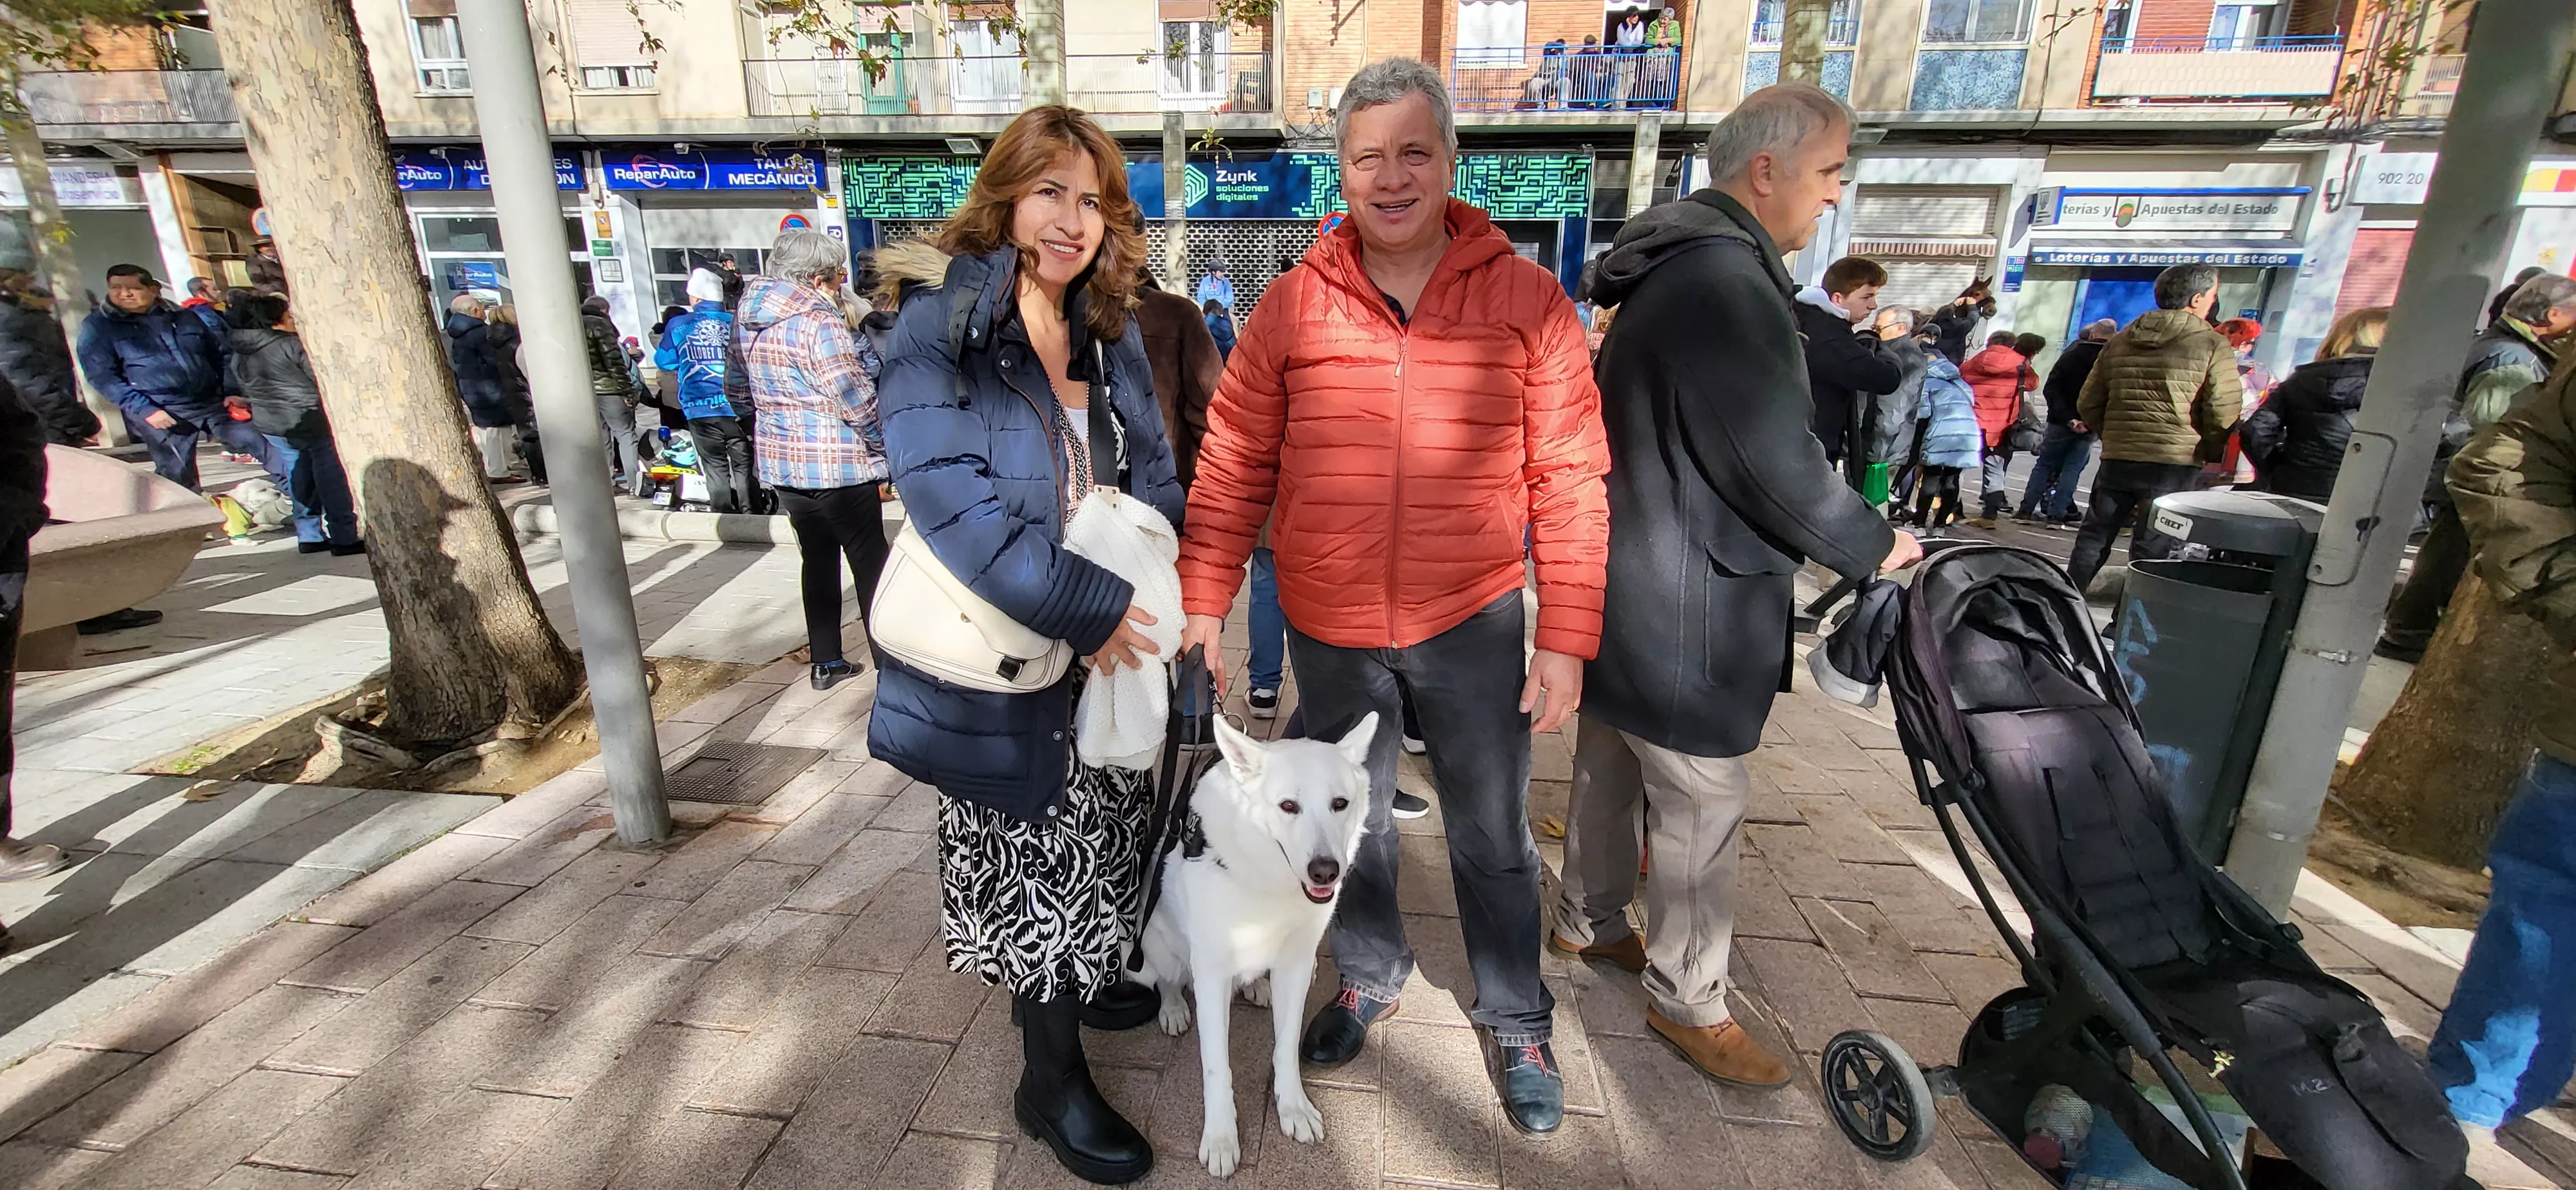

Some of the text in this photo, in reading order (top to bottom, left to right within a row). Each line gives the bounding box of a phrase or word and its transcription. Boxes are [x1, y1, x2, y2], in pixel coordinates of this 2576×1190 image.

[614, 167, 696, 182] ReparAuto
[728, 171, 817, 185] MECÁNICO
[1216, 169, 1258, 184] Zynk
[2378, 172, 2424, 185] 902 20
[1216, 184, 1269, 193] soluciones
[1216, 193, 1259, 203] digitales
[2063, 203, 2279, 218] terías y Apuestas del Estado
[2050, 252, 2287, 264] Loterías y Apuestas del Estado
[690, 346, 727, 360] LLORET DE
[2160, 516, 2184, 531] CHEF
